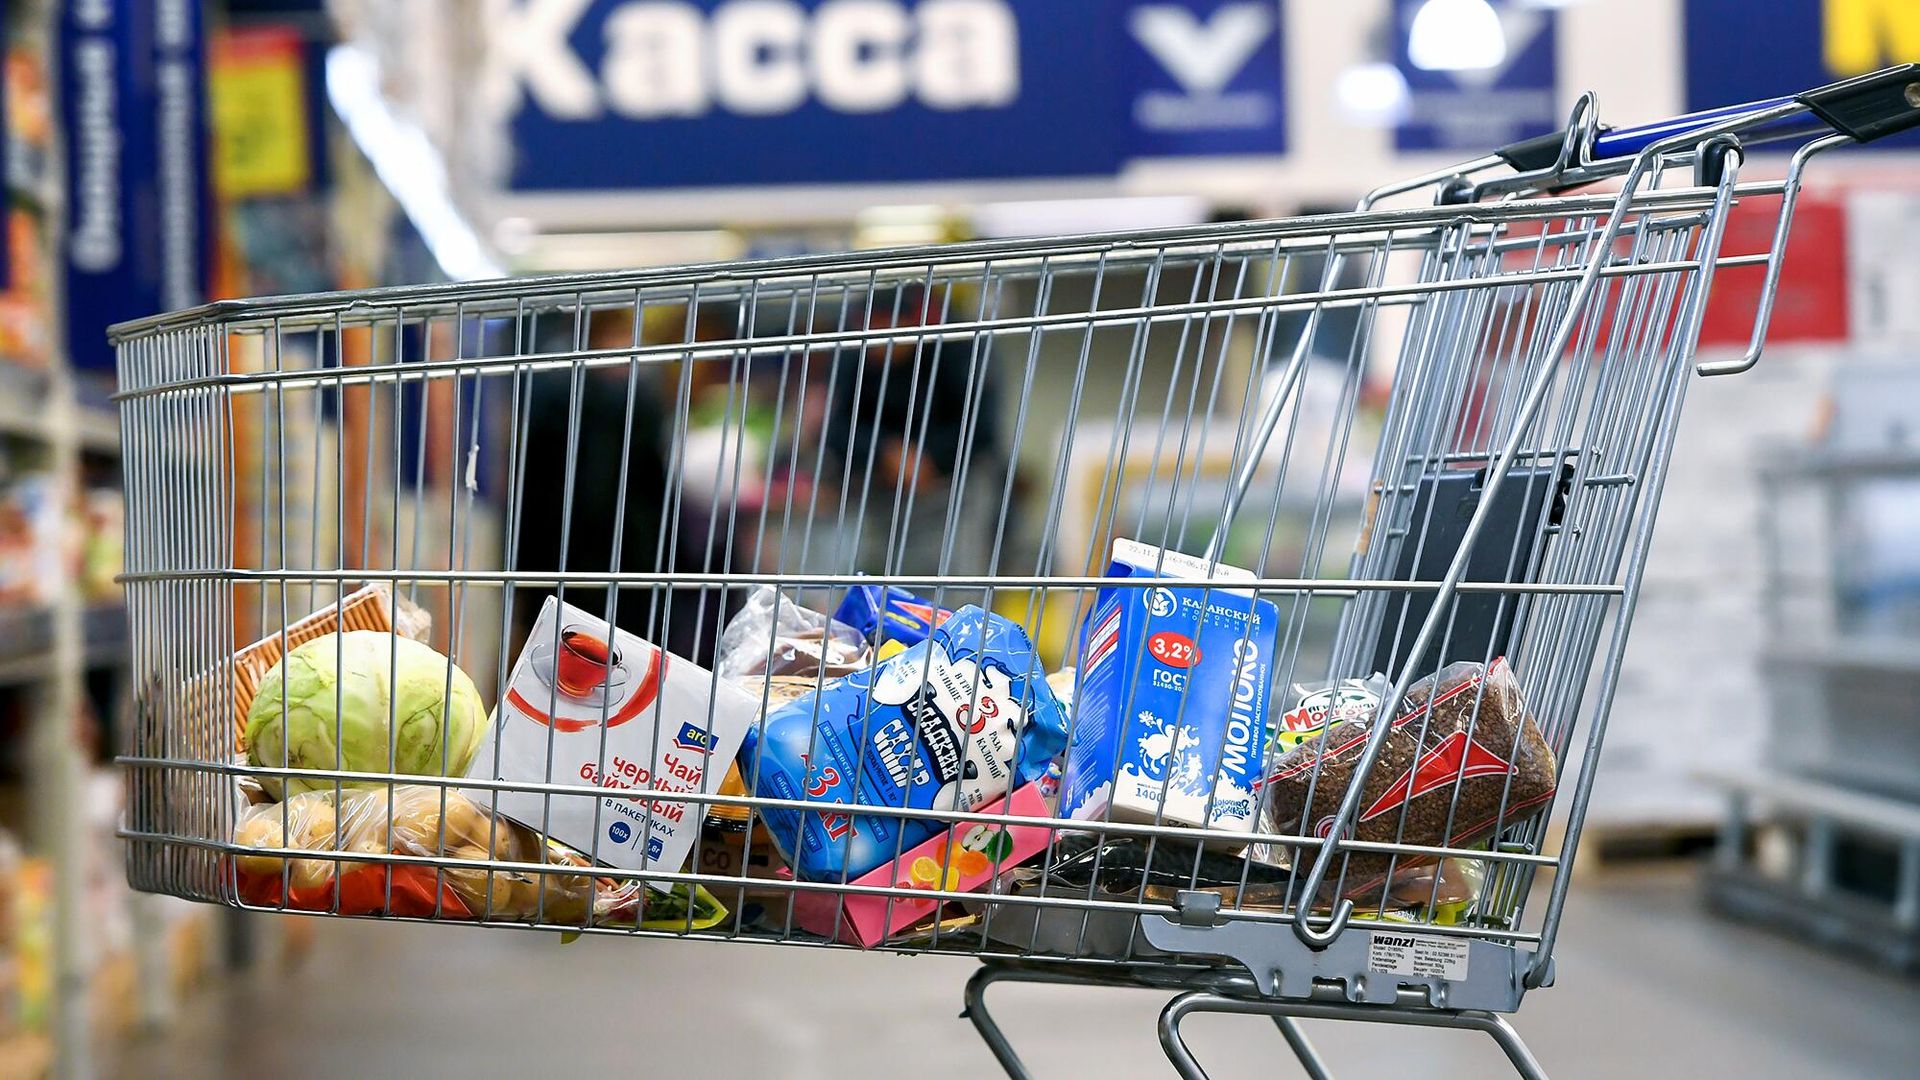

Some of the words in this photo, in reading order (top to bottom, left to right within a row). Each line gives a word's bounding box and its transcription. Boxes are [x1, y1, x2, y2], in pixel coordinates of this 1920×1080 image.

[490, 0, 1020, 120] Касса
[1182, 597, 1261, 625] КААНСКИЙ
[1182, 613, 1259, 636] КОМБИНТ
[1154, 638, 1197, 664] 3,2%
[955, 696, 999, 734] 3
[1222, 638, 1259, 775] МОЛОКО
[874, 719, 930, 788] САХАР
[906, 699, 960, 782] СЛАДКИЙ
[989, 731, 1003, 752] РАЗА
[1251, 725, 1260, 758] ПИТЬЕВОЕ
[664, 753, 703, 785] Чай
[605, 799, 613, 807] В
[1374, 936, 1415, 947] wanzl
